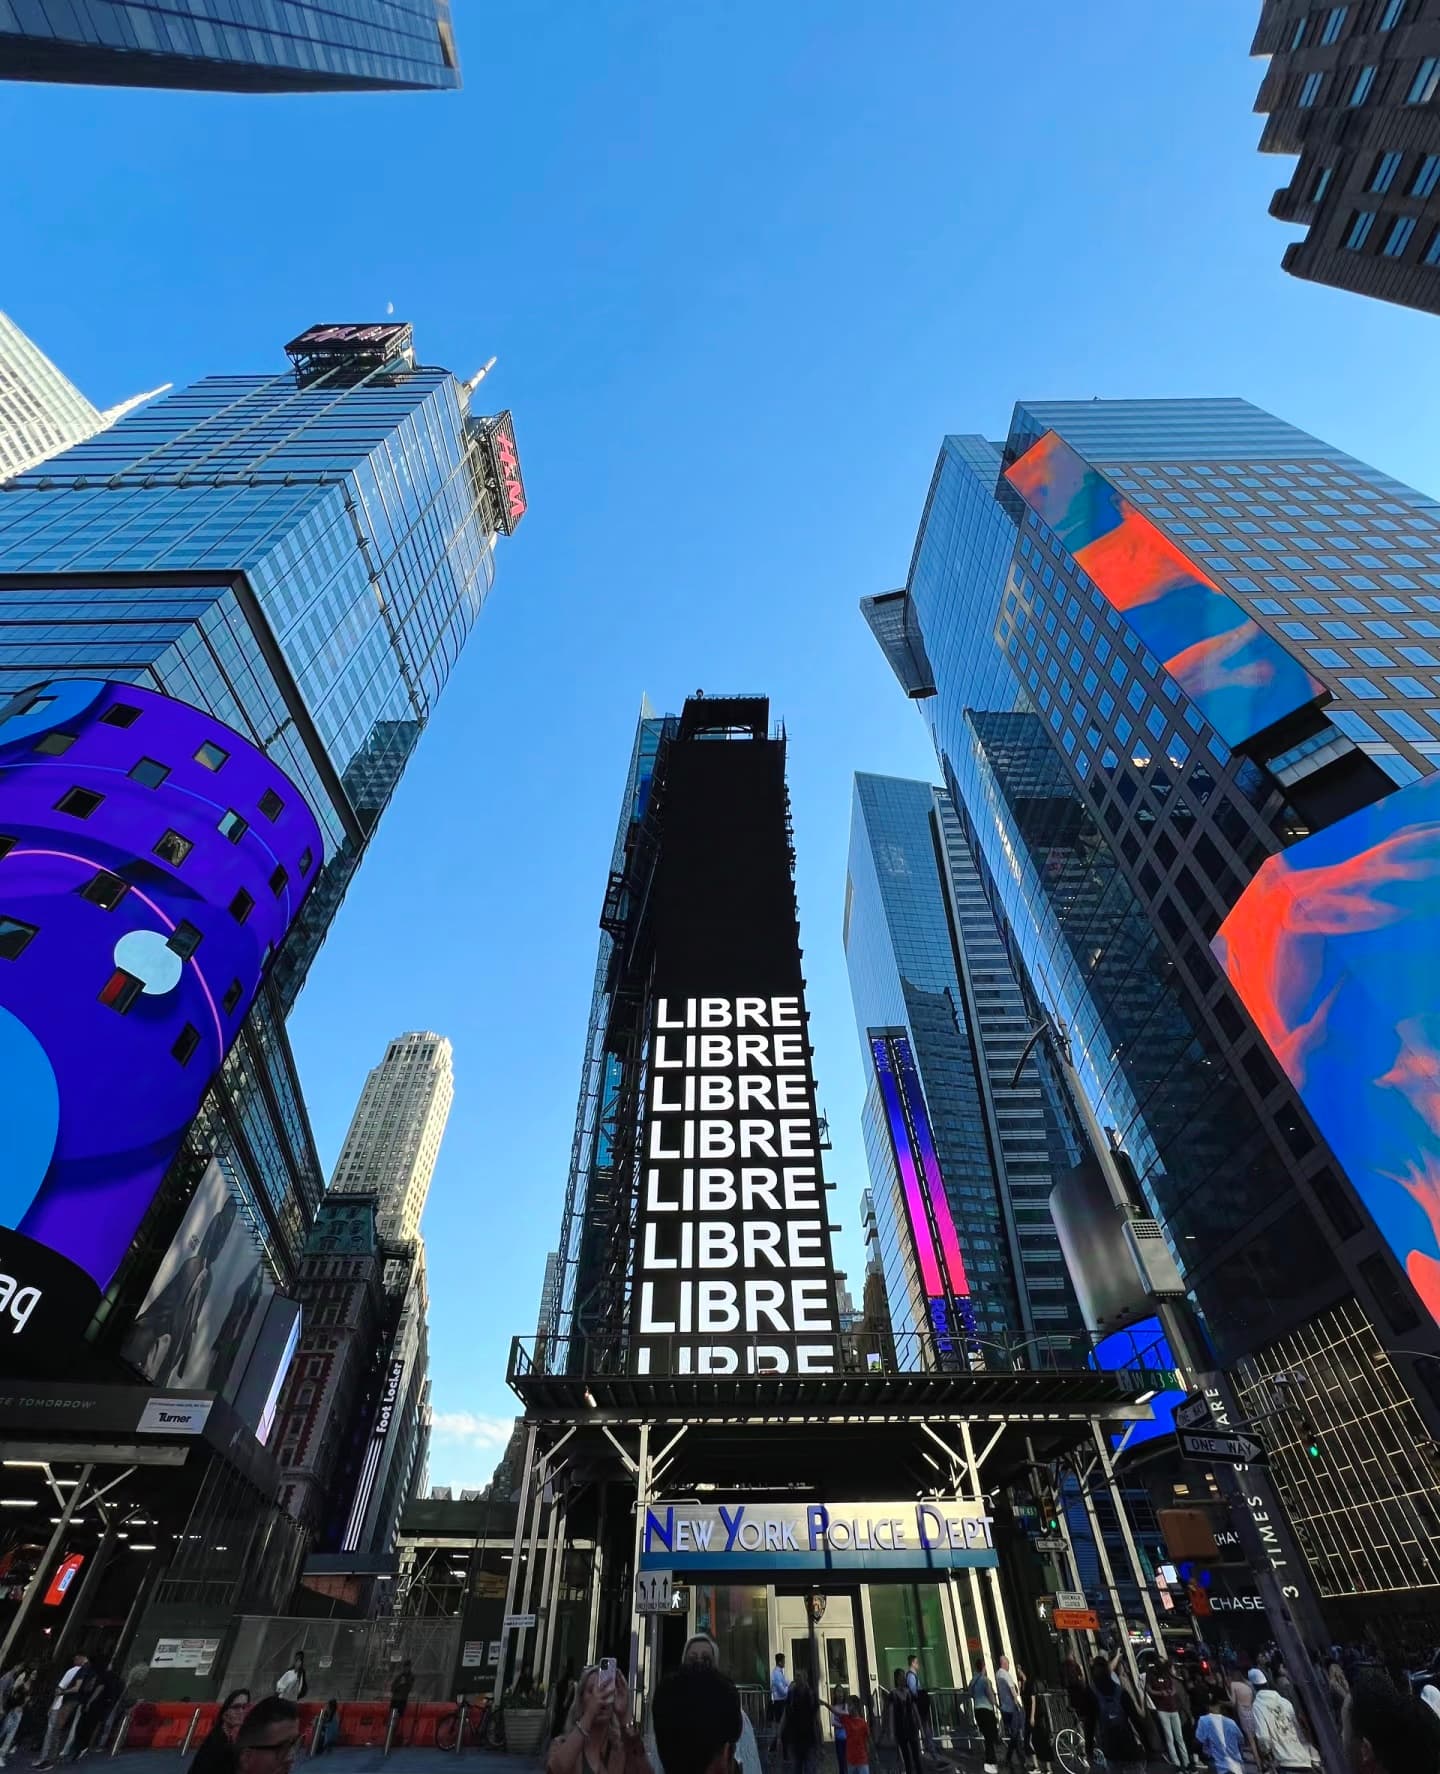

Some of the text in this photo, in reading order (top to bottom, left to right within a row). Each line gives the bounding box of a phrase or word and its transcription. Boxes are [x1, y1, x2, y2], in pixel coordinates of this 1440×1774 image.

[657, 997, 801, 1028] LIBRE
[655, 1034, 805, 1068] LIBRE
[652, 1075, 809, 1111] LIBRE
[650, 1119, 815, 1159] LIBRE
[647, 1167, 819, 1211] LIBRE
[643, 1220, 826, 1269] LIBRE
[640, 1280, 832, 1333] LIBRE
[158, 1412, 192, 1423] Turner
[1191, 1438, 1251, 1455] ONE WAY
[645, 1504, 994, 1552] NEW YORK POLICE DEPT
[1213, 1531, 1240, 1546] CHA
[1248, 1496, 1287, 1569] TIMES
[1209, 1596, 1264, 1610] CHASE
[1282, 1585, 1300, 1598] 3
